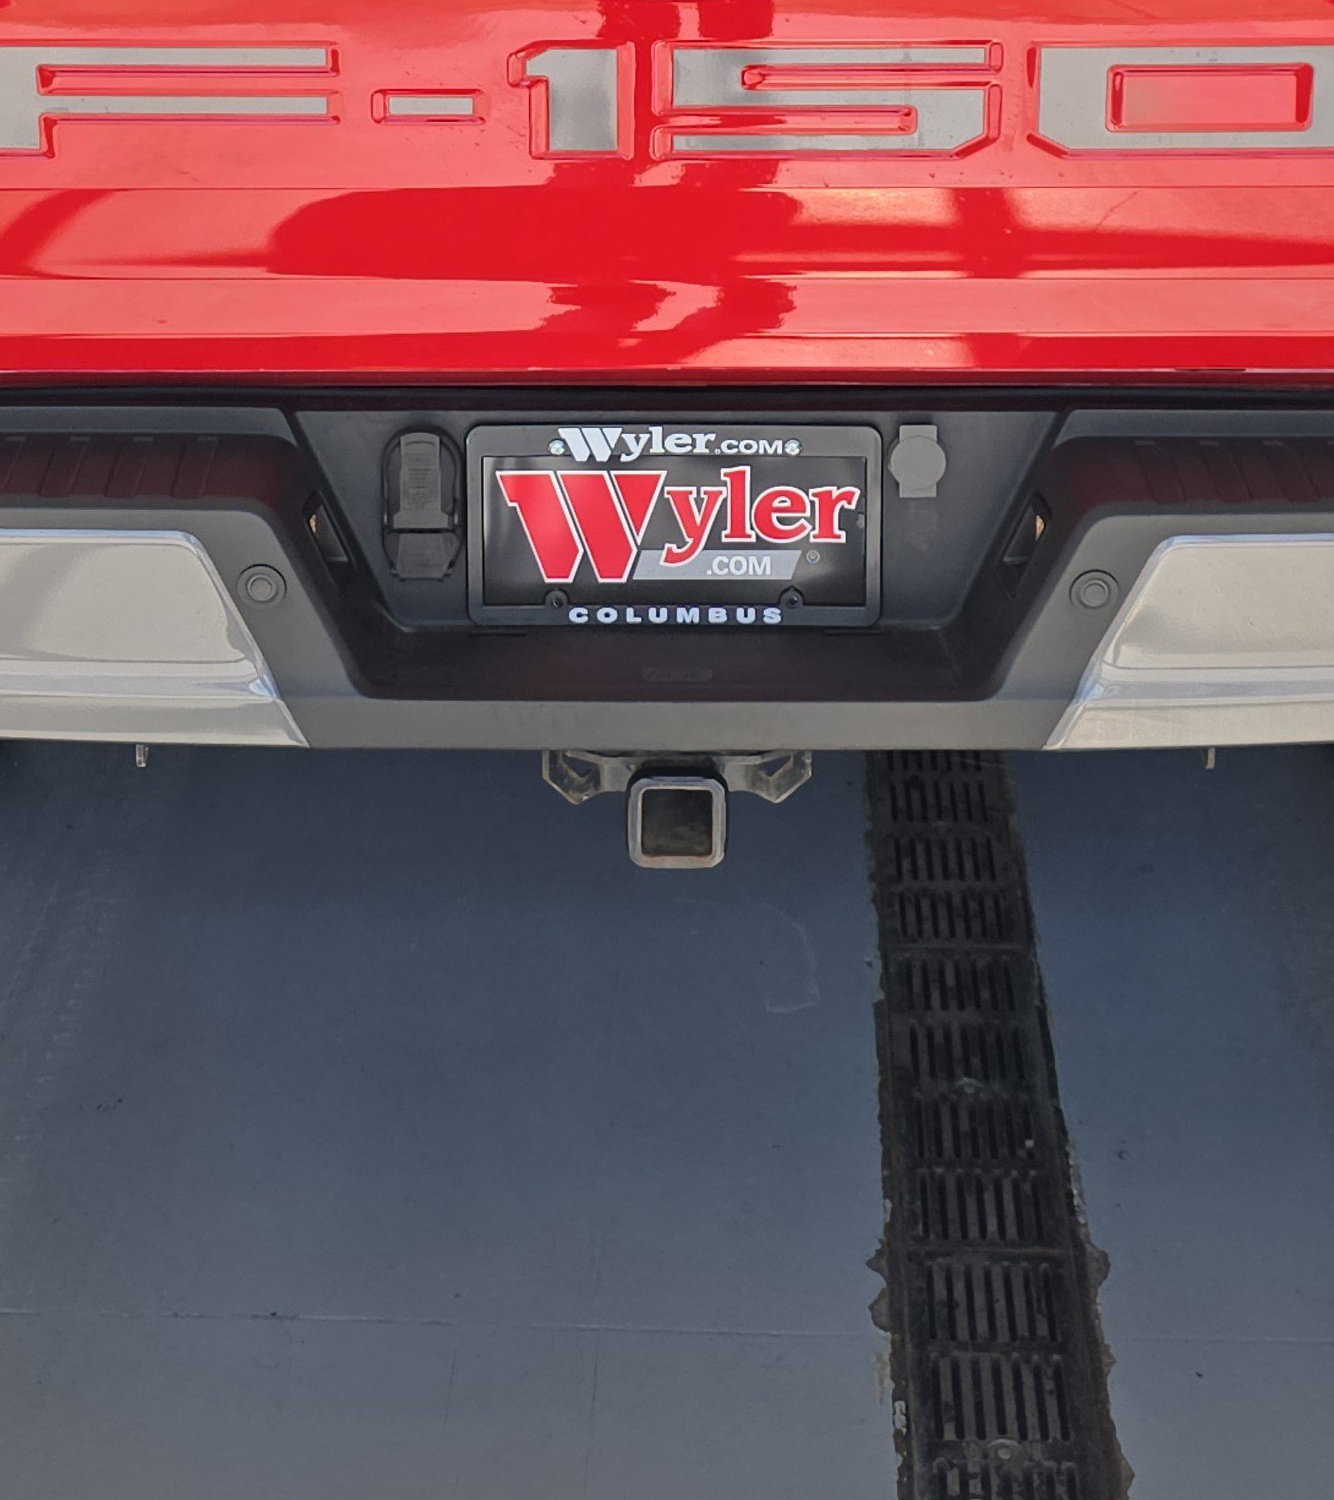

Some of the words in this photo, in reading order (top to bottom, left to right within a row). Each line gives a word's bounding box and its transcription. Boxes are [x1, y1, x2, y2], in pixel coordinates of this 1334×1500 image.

[495, 465, 861, 584] Wyler
[705, 555, 773, 576] .COM
[568, 606, 784, 625] COLUMBUS
